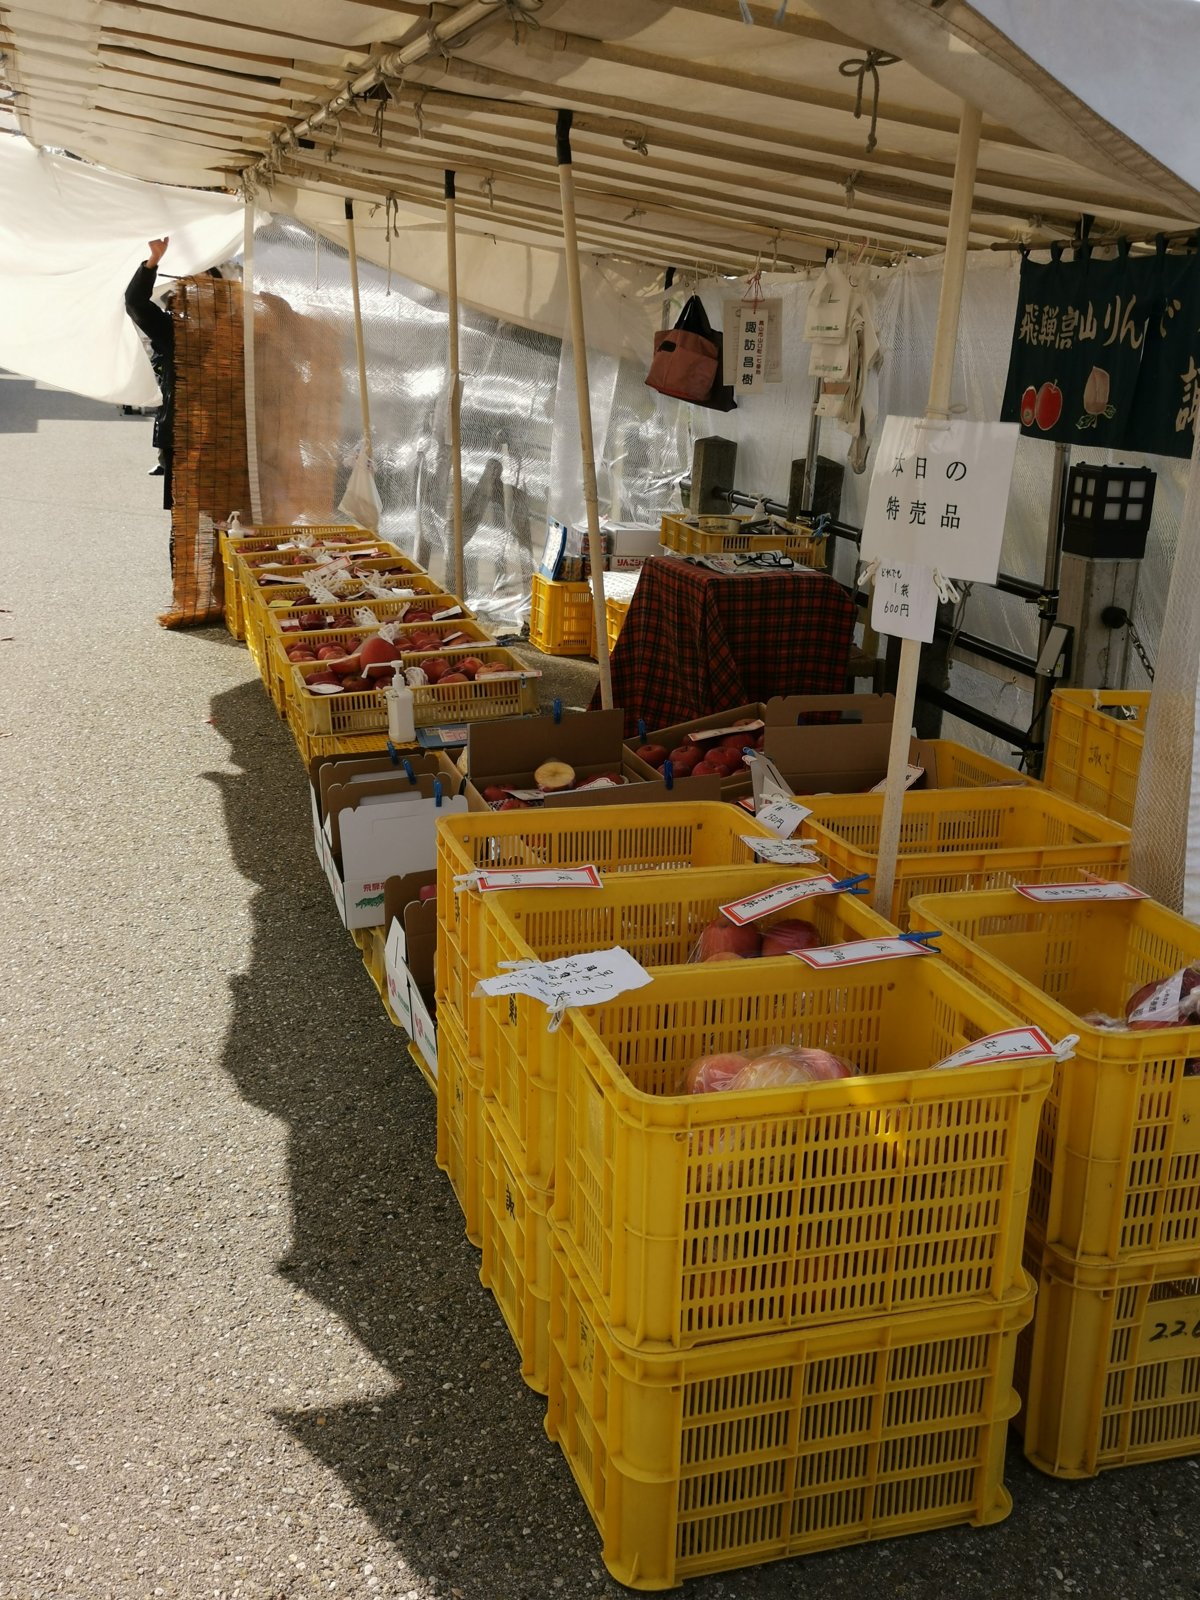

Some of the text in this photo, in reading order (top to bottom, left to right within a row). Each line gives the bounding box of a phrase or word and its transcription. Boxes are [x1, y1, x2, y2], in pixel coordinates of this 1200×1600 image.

[891, 452, 967, 482] 本日の
[886, 495, 961, 529] 特売品
[884, 601, 910, 618] 600円
